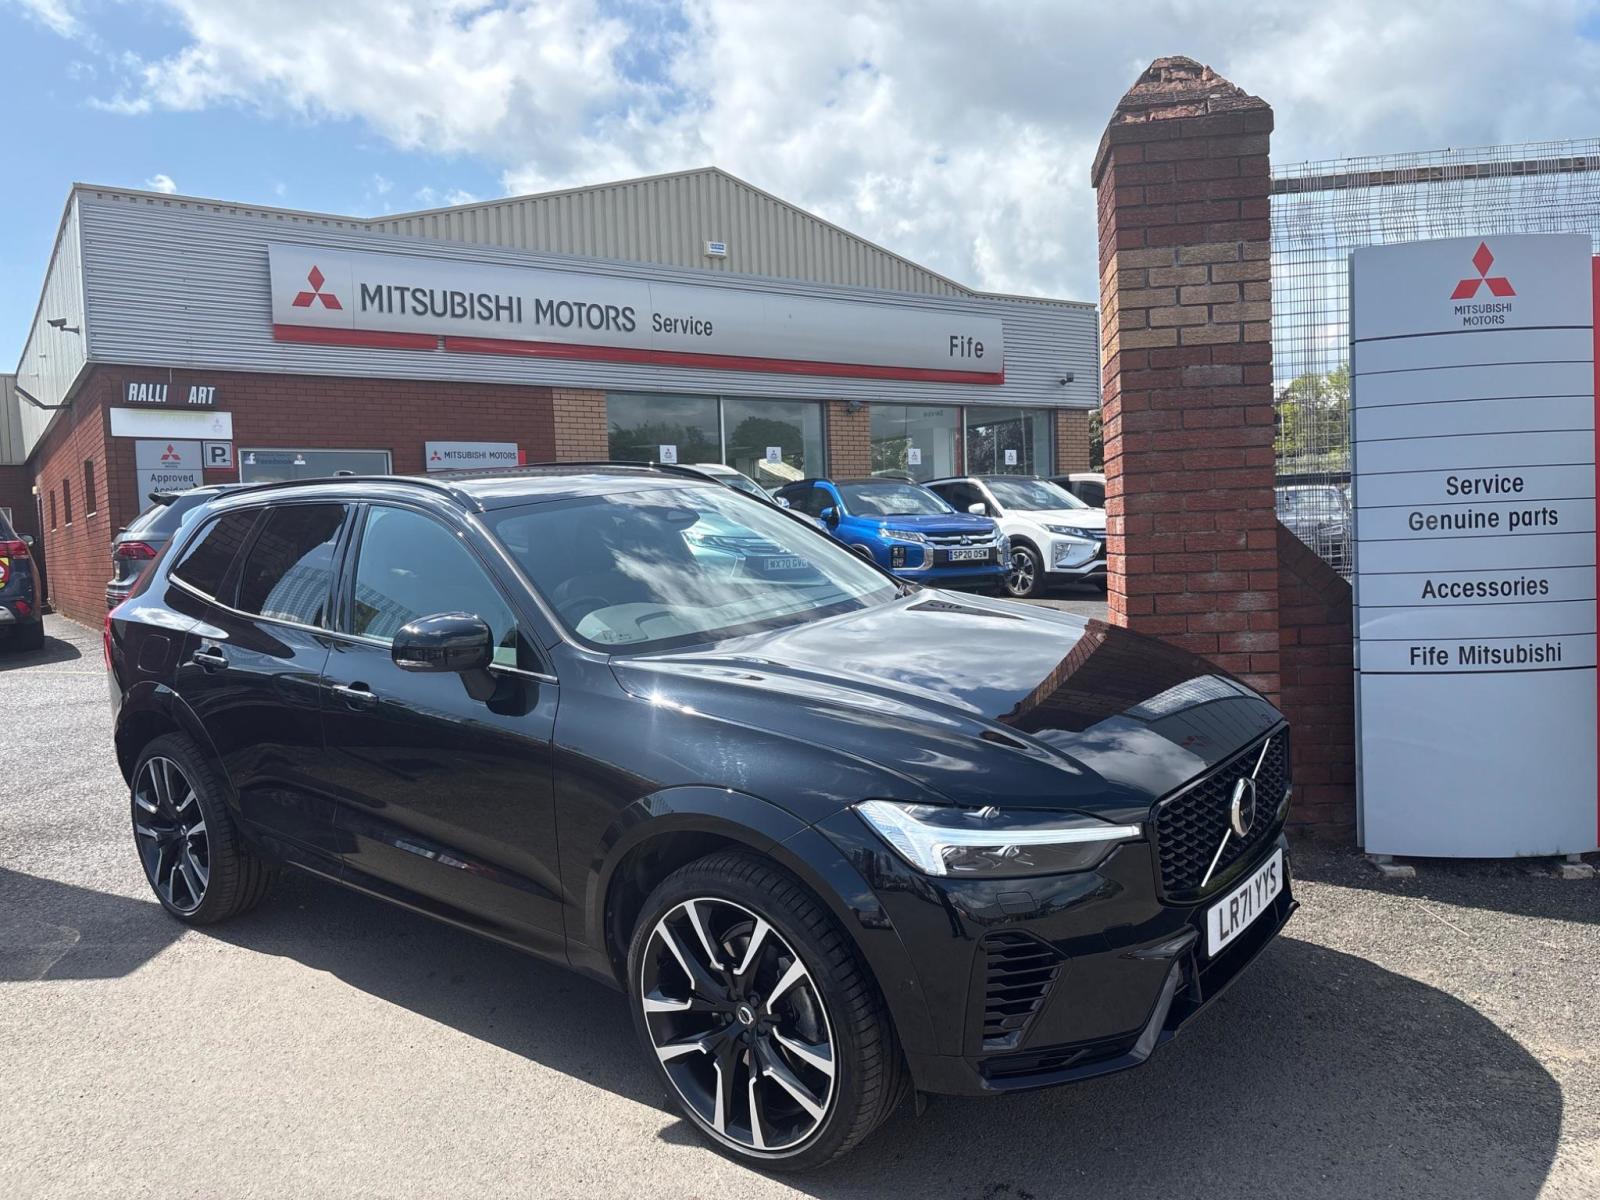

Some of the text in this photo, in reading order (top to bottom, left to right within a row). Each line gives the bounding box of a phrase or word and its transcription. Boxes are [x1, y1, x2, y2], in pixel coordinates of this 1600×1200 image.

[360, 283, 713, 336] MITSUBISHI MOTORS Service
[1454, 303, 1512, 326] MITSUBISHI MOTORS
[949, 335, 984, 358] Fife
[128, 383, 216, 404] RALLI ART
[210, 446, 226, 463] P
[444, 451, 517, 460] MITSUBISHI MOTORS
[150, 473, 194, 484] Approved
[1446, 474, 1524, 496] Service
[1408, 507, 1559, 531] Genuine parts
[953, 551, 972, 559] SP20
[1421, 576, 1549, 599] Accessories
[1410, 643, 1562, 666] Fife Mitsubishi
[1218, 861, 1277, 941] LR71 YYS
